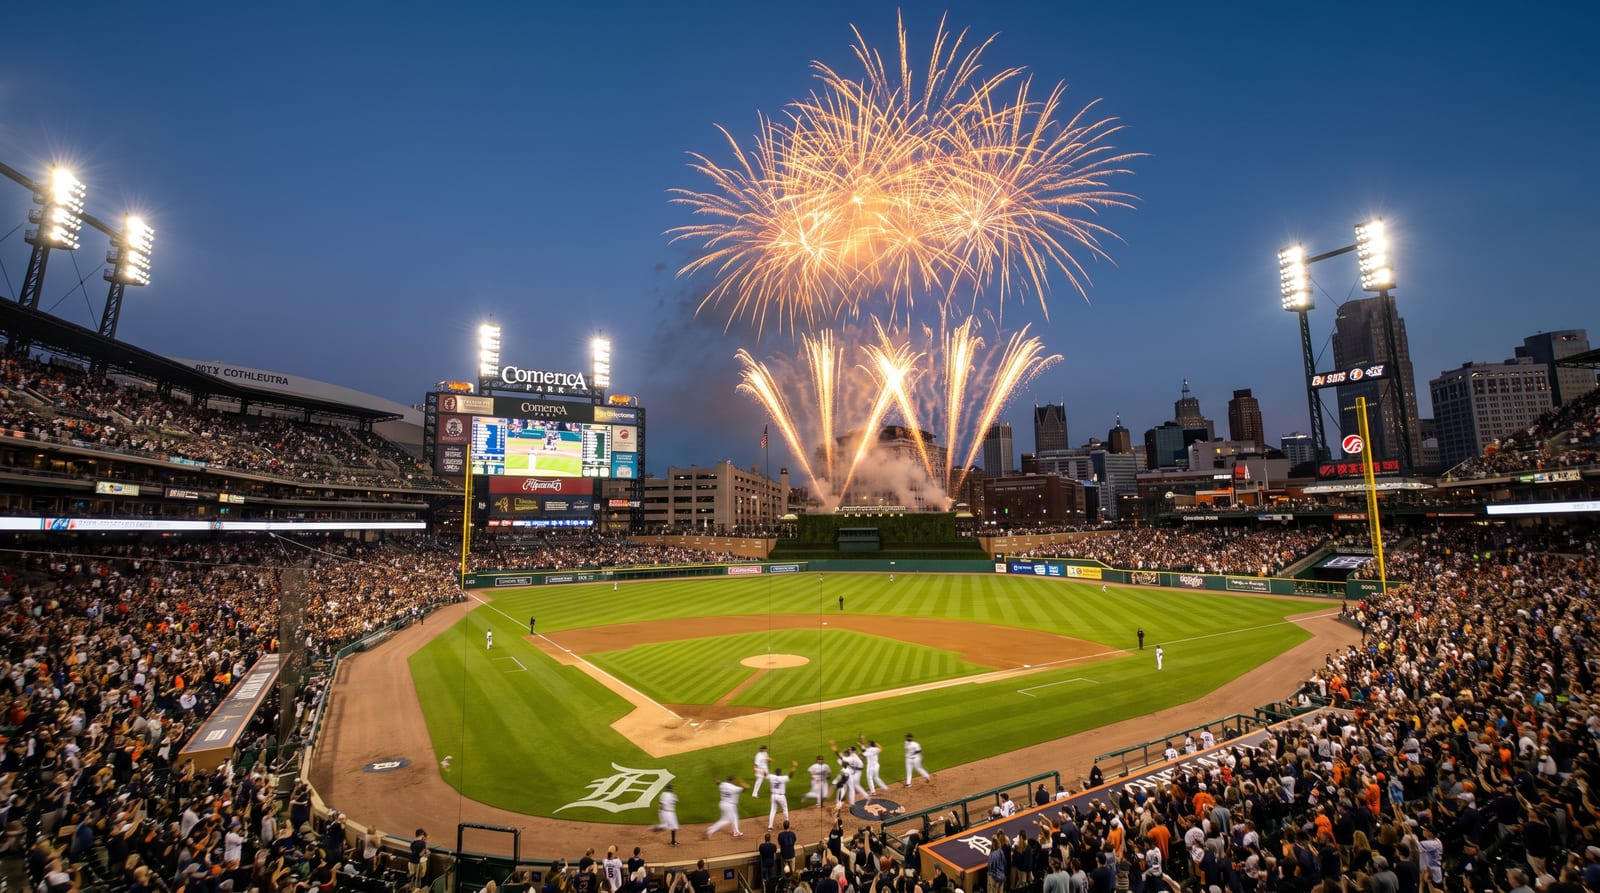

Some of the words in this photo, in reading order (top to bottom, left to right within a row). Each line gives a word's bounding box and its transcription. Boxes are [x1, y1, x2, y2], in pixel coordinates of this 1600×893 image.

[526, 384, 565, 394] PARK
[551, 761, 676, 814] D
[607, 867, 614, 879] 5
